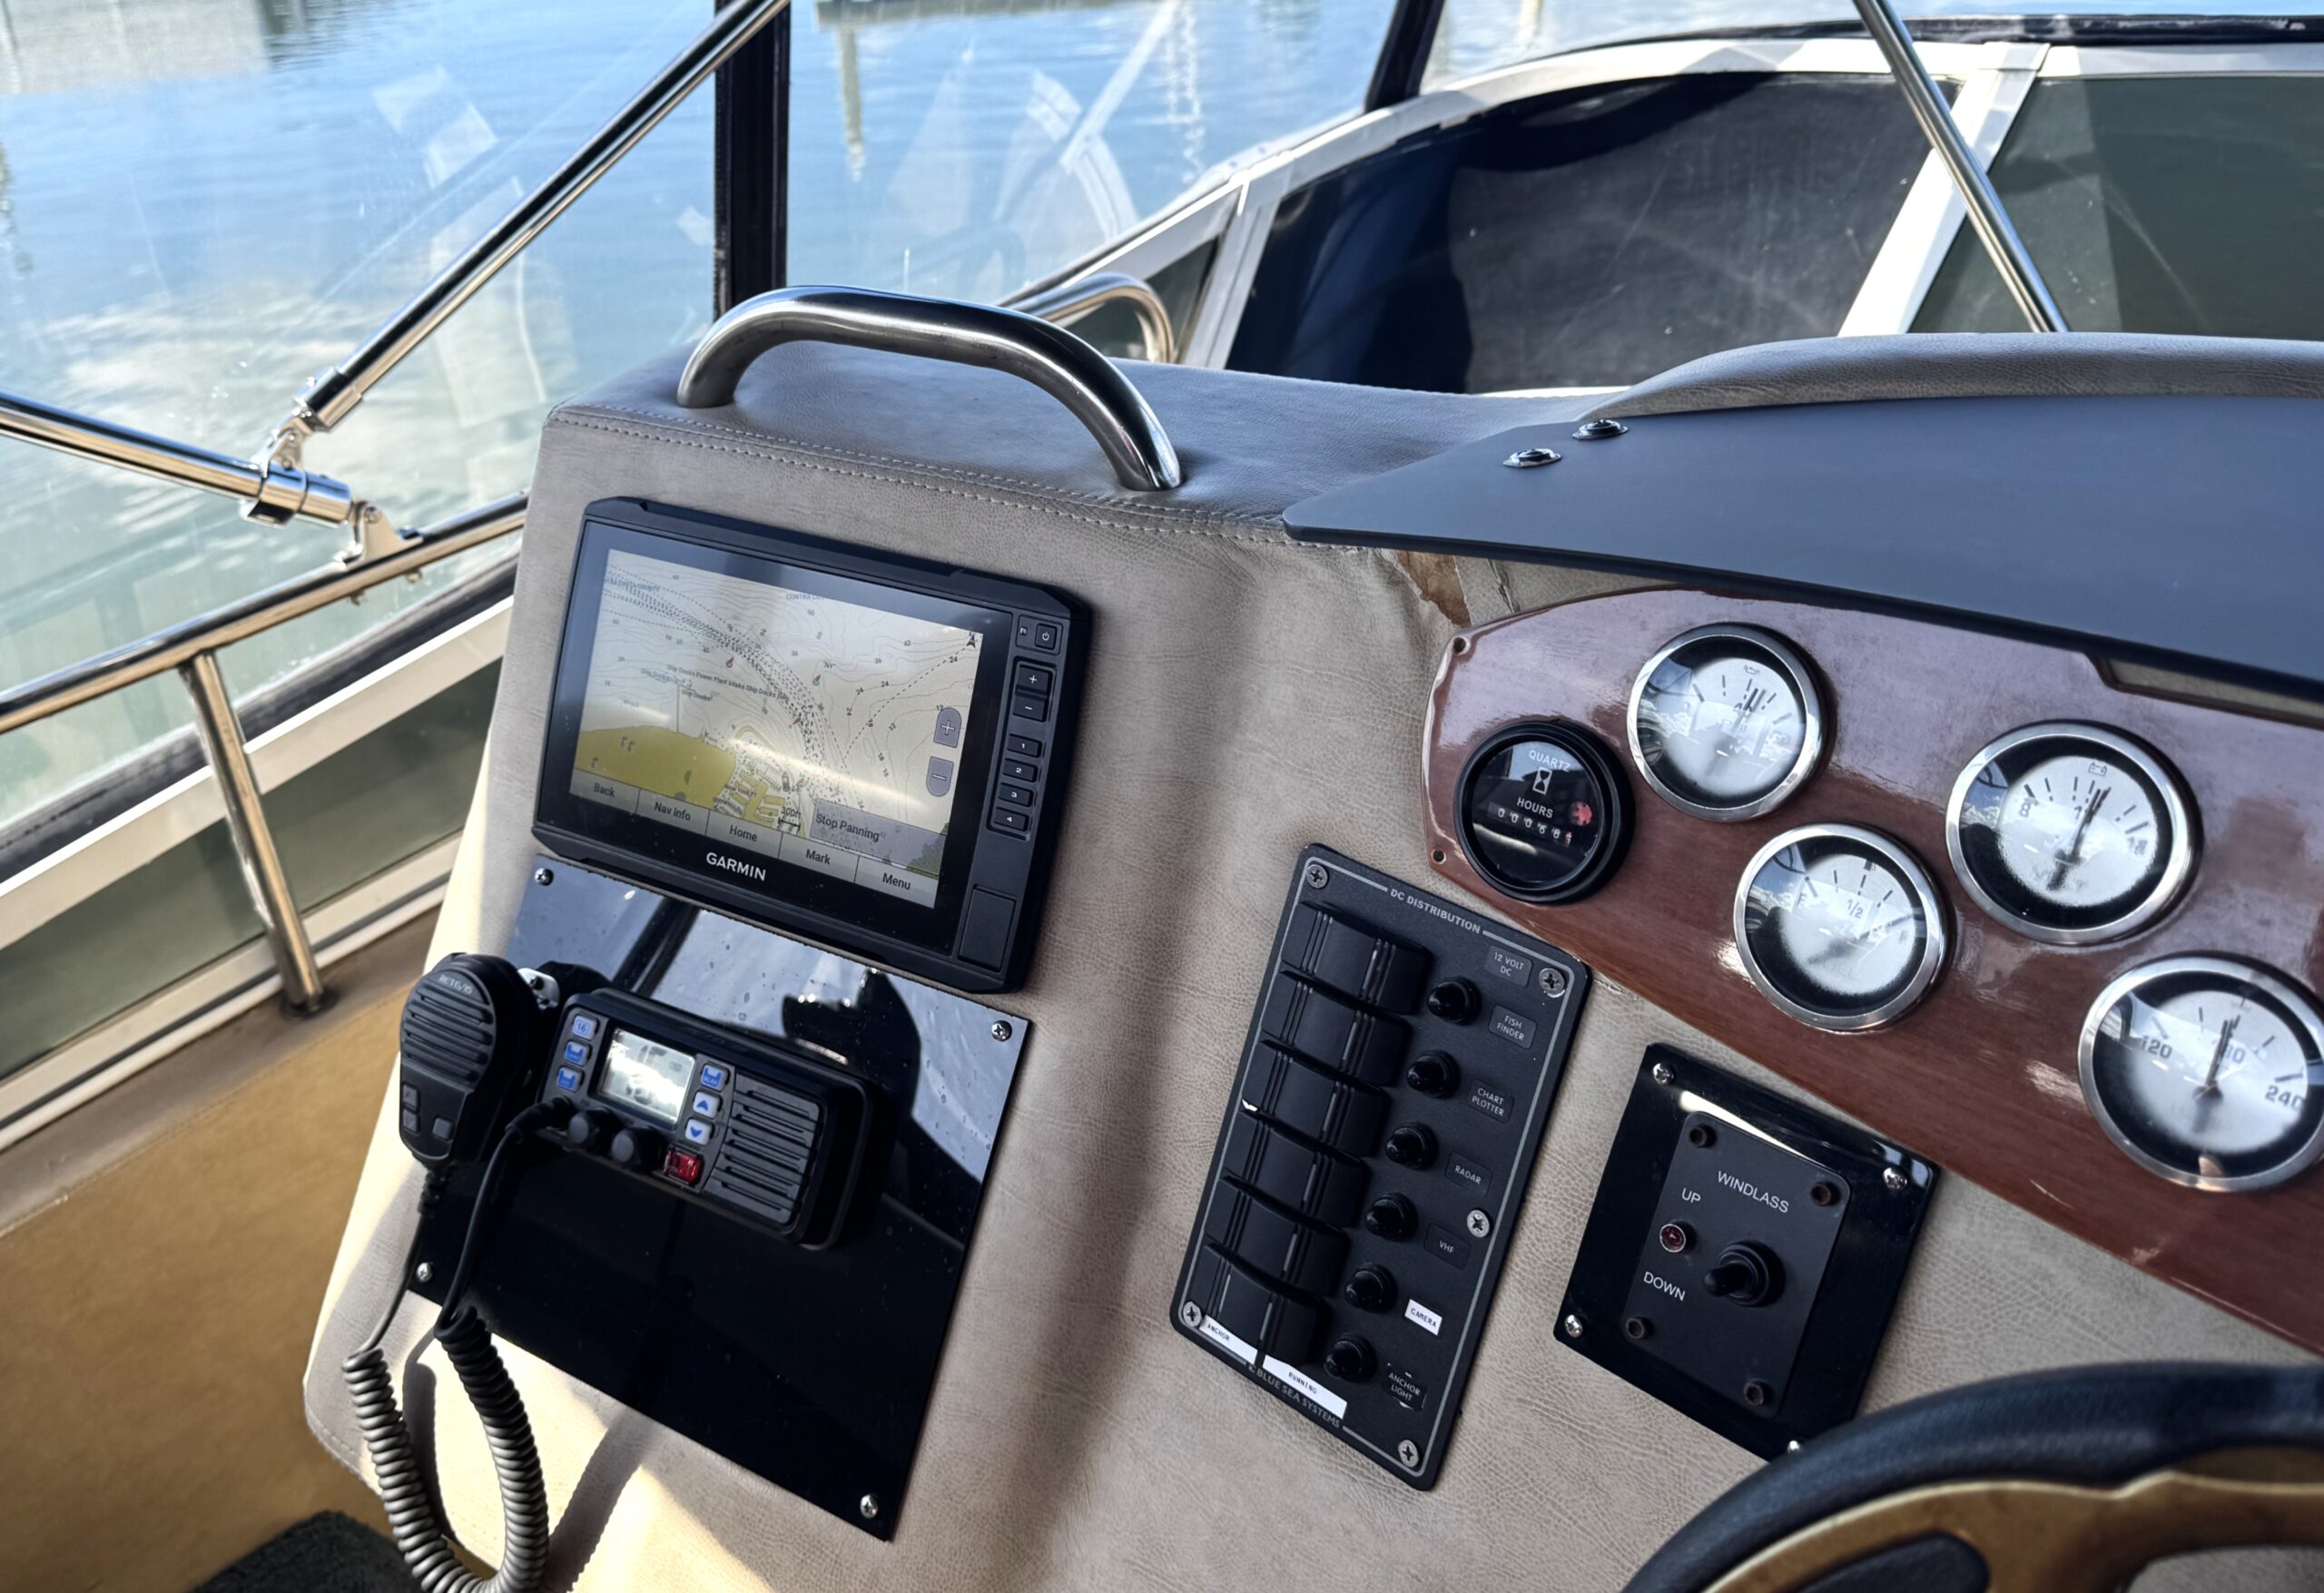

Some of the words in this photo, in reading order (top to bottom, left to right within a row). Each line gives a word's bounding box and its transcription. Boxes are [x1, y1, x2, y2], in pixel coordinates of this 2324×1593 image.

[1529, 750, 1572, 772] QUARTZ
[594, 782, 615, 798] Back
[655, 801, 672, 816] Nav
[674, 807, 691, 821] Info
[1516, 797, 1554, 819] HOURS
[729, 825, 758, 842] Home
[815, 813, 838, 830] Stop
[840, 821, 881, 842] Panning
[705, 851, 766, 881] GARMIN
[805, 849, 831, 865] Mark
[882, 872, 911, 890] Menu
[1390, 888, 1405, 900] DC
[1406, 895, 1481, 934] DISTRIBUTION
[1846, 899, 1864, 919] 1/2
[1494, 952, 1503, 962] 12
[1505, 956, 1524, 971] VOLT
[1500, 966, 1512, 977] DC
[577, 1022, 587, 1033] 16
[1497, 1022, 1524, 1041] FINDER
[1504, 1015, 1522, 1029] FISH
[2141, 1035, 2173, 1059] 120
[1472, 1096, 1504, 1117] PLOTTER
[1477, 1087, 1504, 1106] CHART
[2264, 1084, 2304, 1111] 240
[1454, 1165, 1482, 1185] RADAR
[1681, 1187, 1701, 1204] UP
[1718, 1170, 1790, 1214] WINDLASS
[1439, 1240, 1454, 1254] VHF
[1643, 1271, 1686, 1302] DOWN
[1411, 1308, 1436, 1328] CAMERA
[1207, 1324, 1230, 1342] ANCHOR
[1288, 1372, 1317, 1394] RUNNING
[1388, 1372, 1421, 1396] ANCHOR
[1391, 1384, 1413, 1401] LIGHT
[1256, 1368, 1280, 1390] BLUE
[1282, 1384, 1300, 1402] SEA
[1302, 1398, 1341, 1429] SYSTEMS
